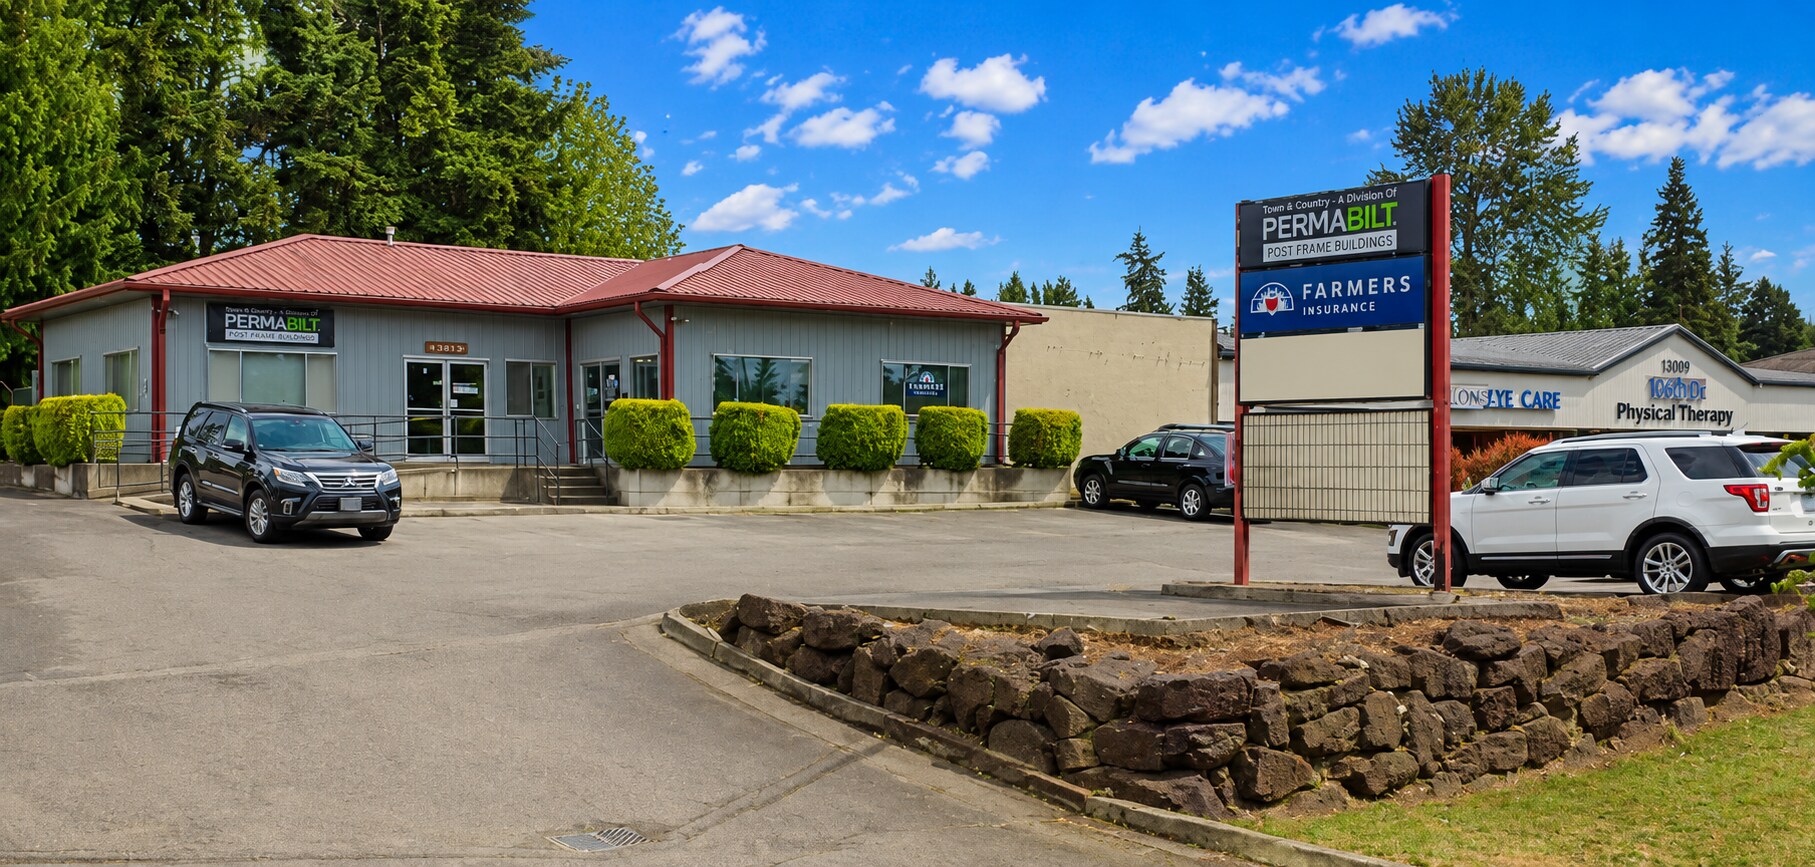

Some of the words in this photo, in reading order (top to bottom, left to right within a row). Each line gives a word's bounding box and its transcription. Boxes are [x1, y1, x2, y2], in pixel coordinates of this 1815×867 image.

[1263, 205, 1285, 215] Town
[1287, 203, 1293, 211] &
[1295, 199, 1330, 210] Country
[1338, 195, 1344, 204] A
[1347, 191, 1384, 204] Division
[1386, 187, 1397, 198] Of
[1267, 245, 1294, 259] POST
[1296, 241, 1332, 256] FRAME
[1334, 235, 1393, 252] BUILDINGS
[1303, 275, 1411, 300] FARMERS
[1303, 301, 1376, 316] INSURANCE
[1661, 359, 1690, 374] 13009
[1521, 389, 1561, 410] CARE
[1617, 402, 1675, 425] Physical
[1678, 404, 1734, 427] Therapy
